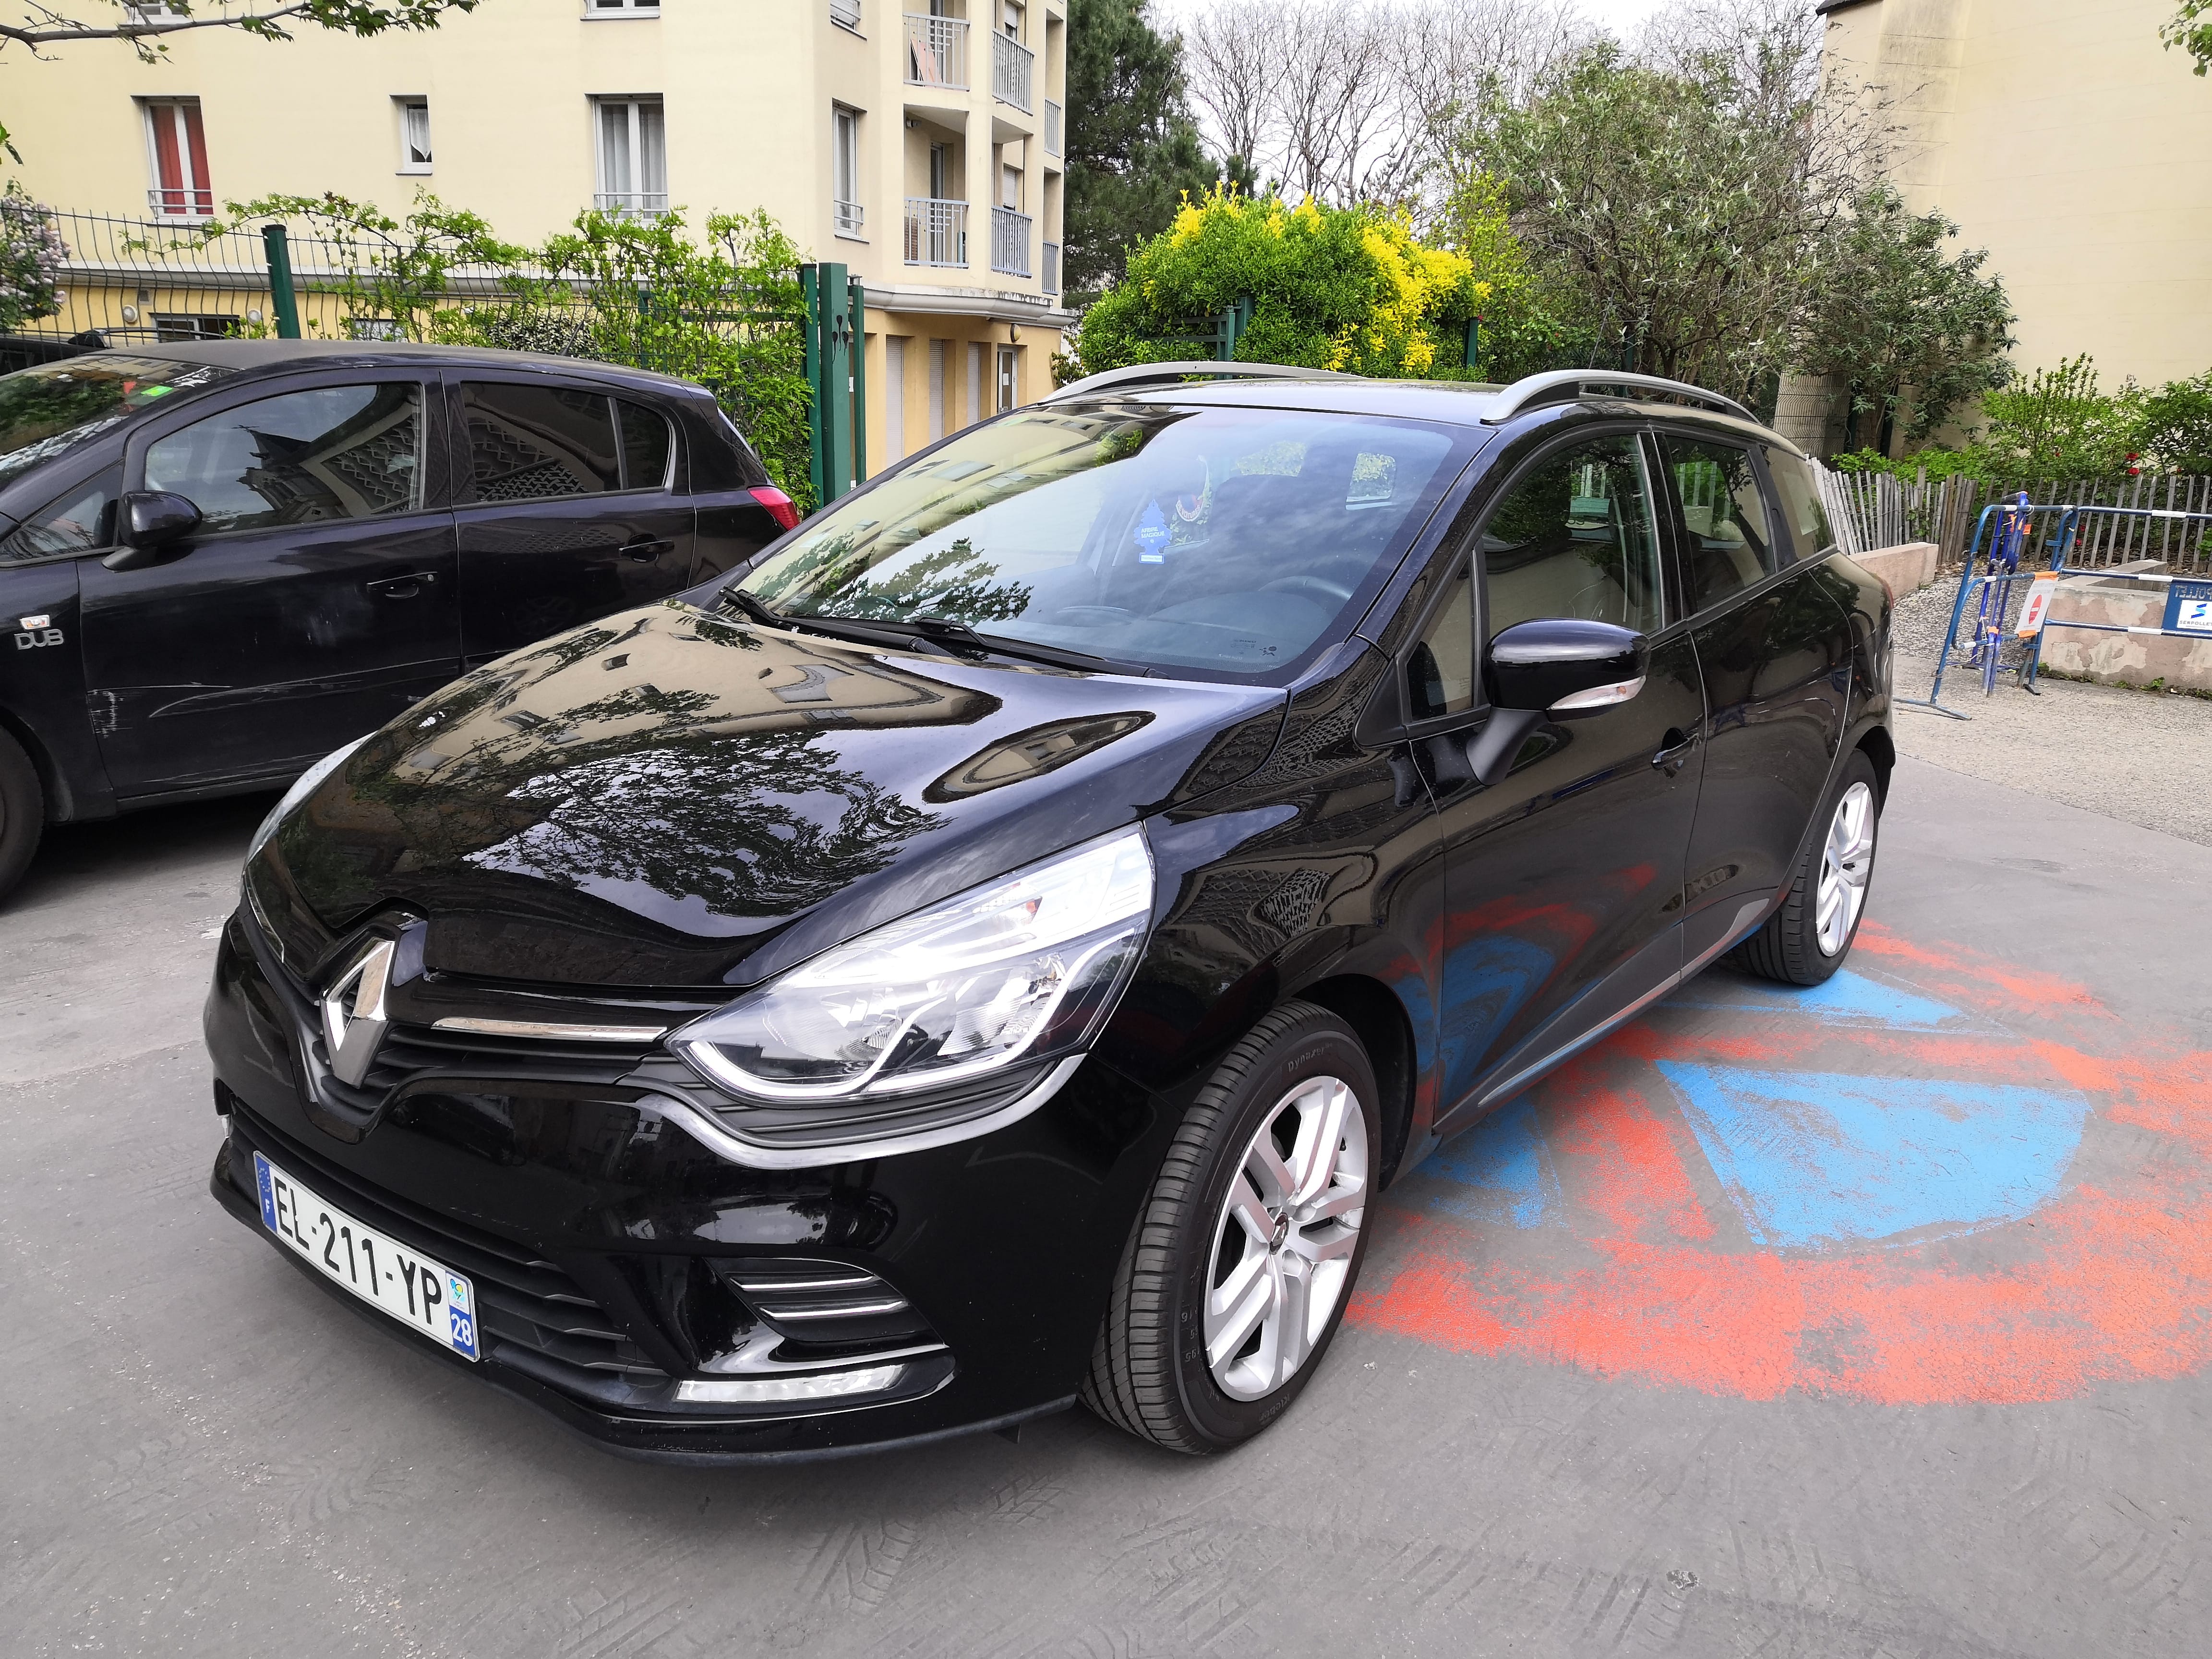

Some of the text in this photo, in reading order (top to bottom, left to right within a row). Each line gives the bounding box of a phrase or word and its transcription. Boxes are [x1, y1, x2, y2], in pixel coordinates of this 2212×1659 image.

[14, 629, 64, 650] DUB
[265, 1199, 270, 1213] F
[274, 1176, 442, 1325] EL-211-YP
[451, 1313, 473, 1346] 28
